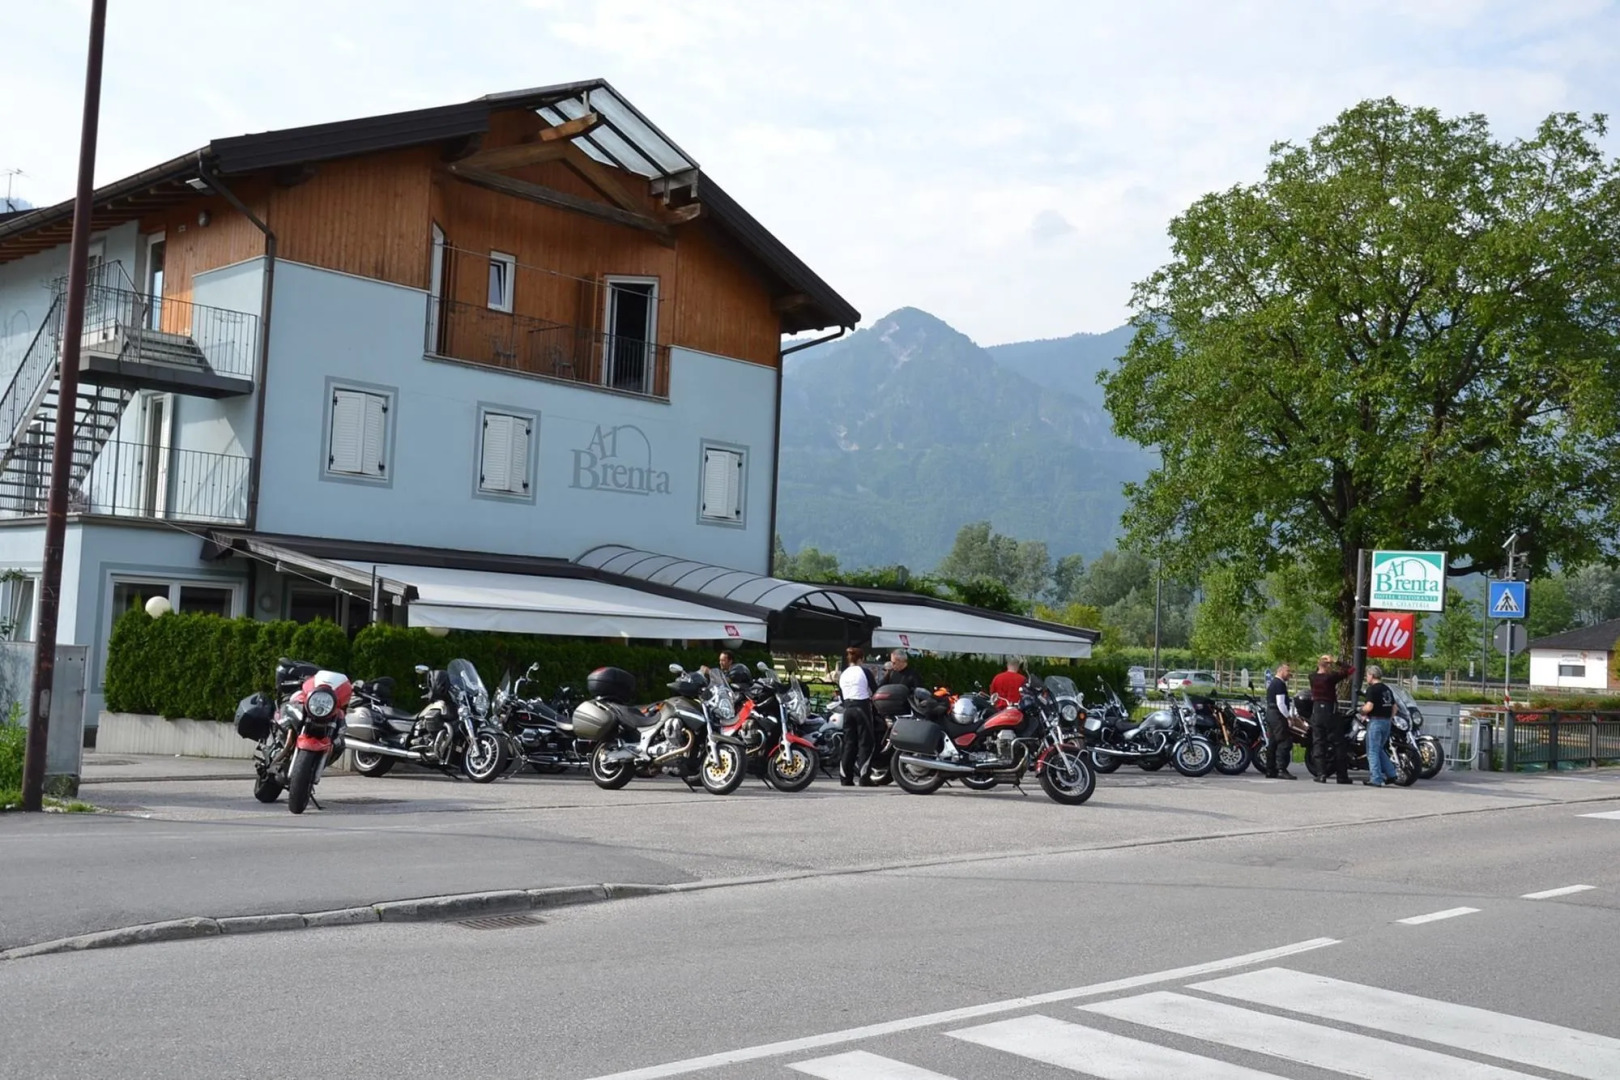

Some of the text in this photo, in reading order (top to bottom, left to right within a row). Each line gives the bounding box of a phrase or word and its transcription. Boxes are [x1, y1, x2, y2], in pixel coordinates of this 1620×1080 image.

[568, 449, 672, 494] Brenta
[1374, 573, 1440, 592] Brenta
[1369, 618, 1409, 654] illy
